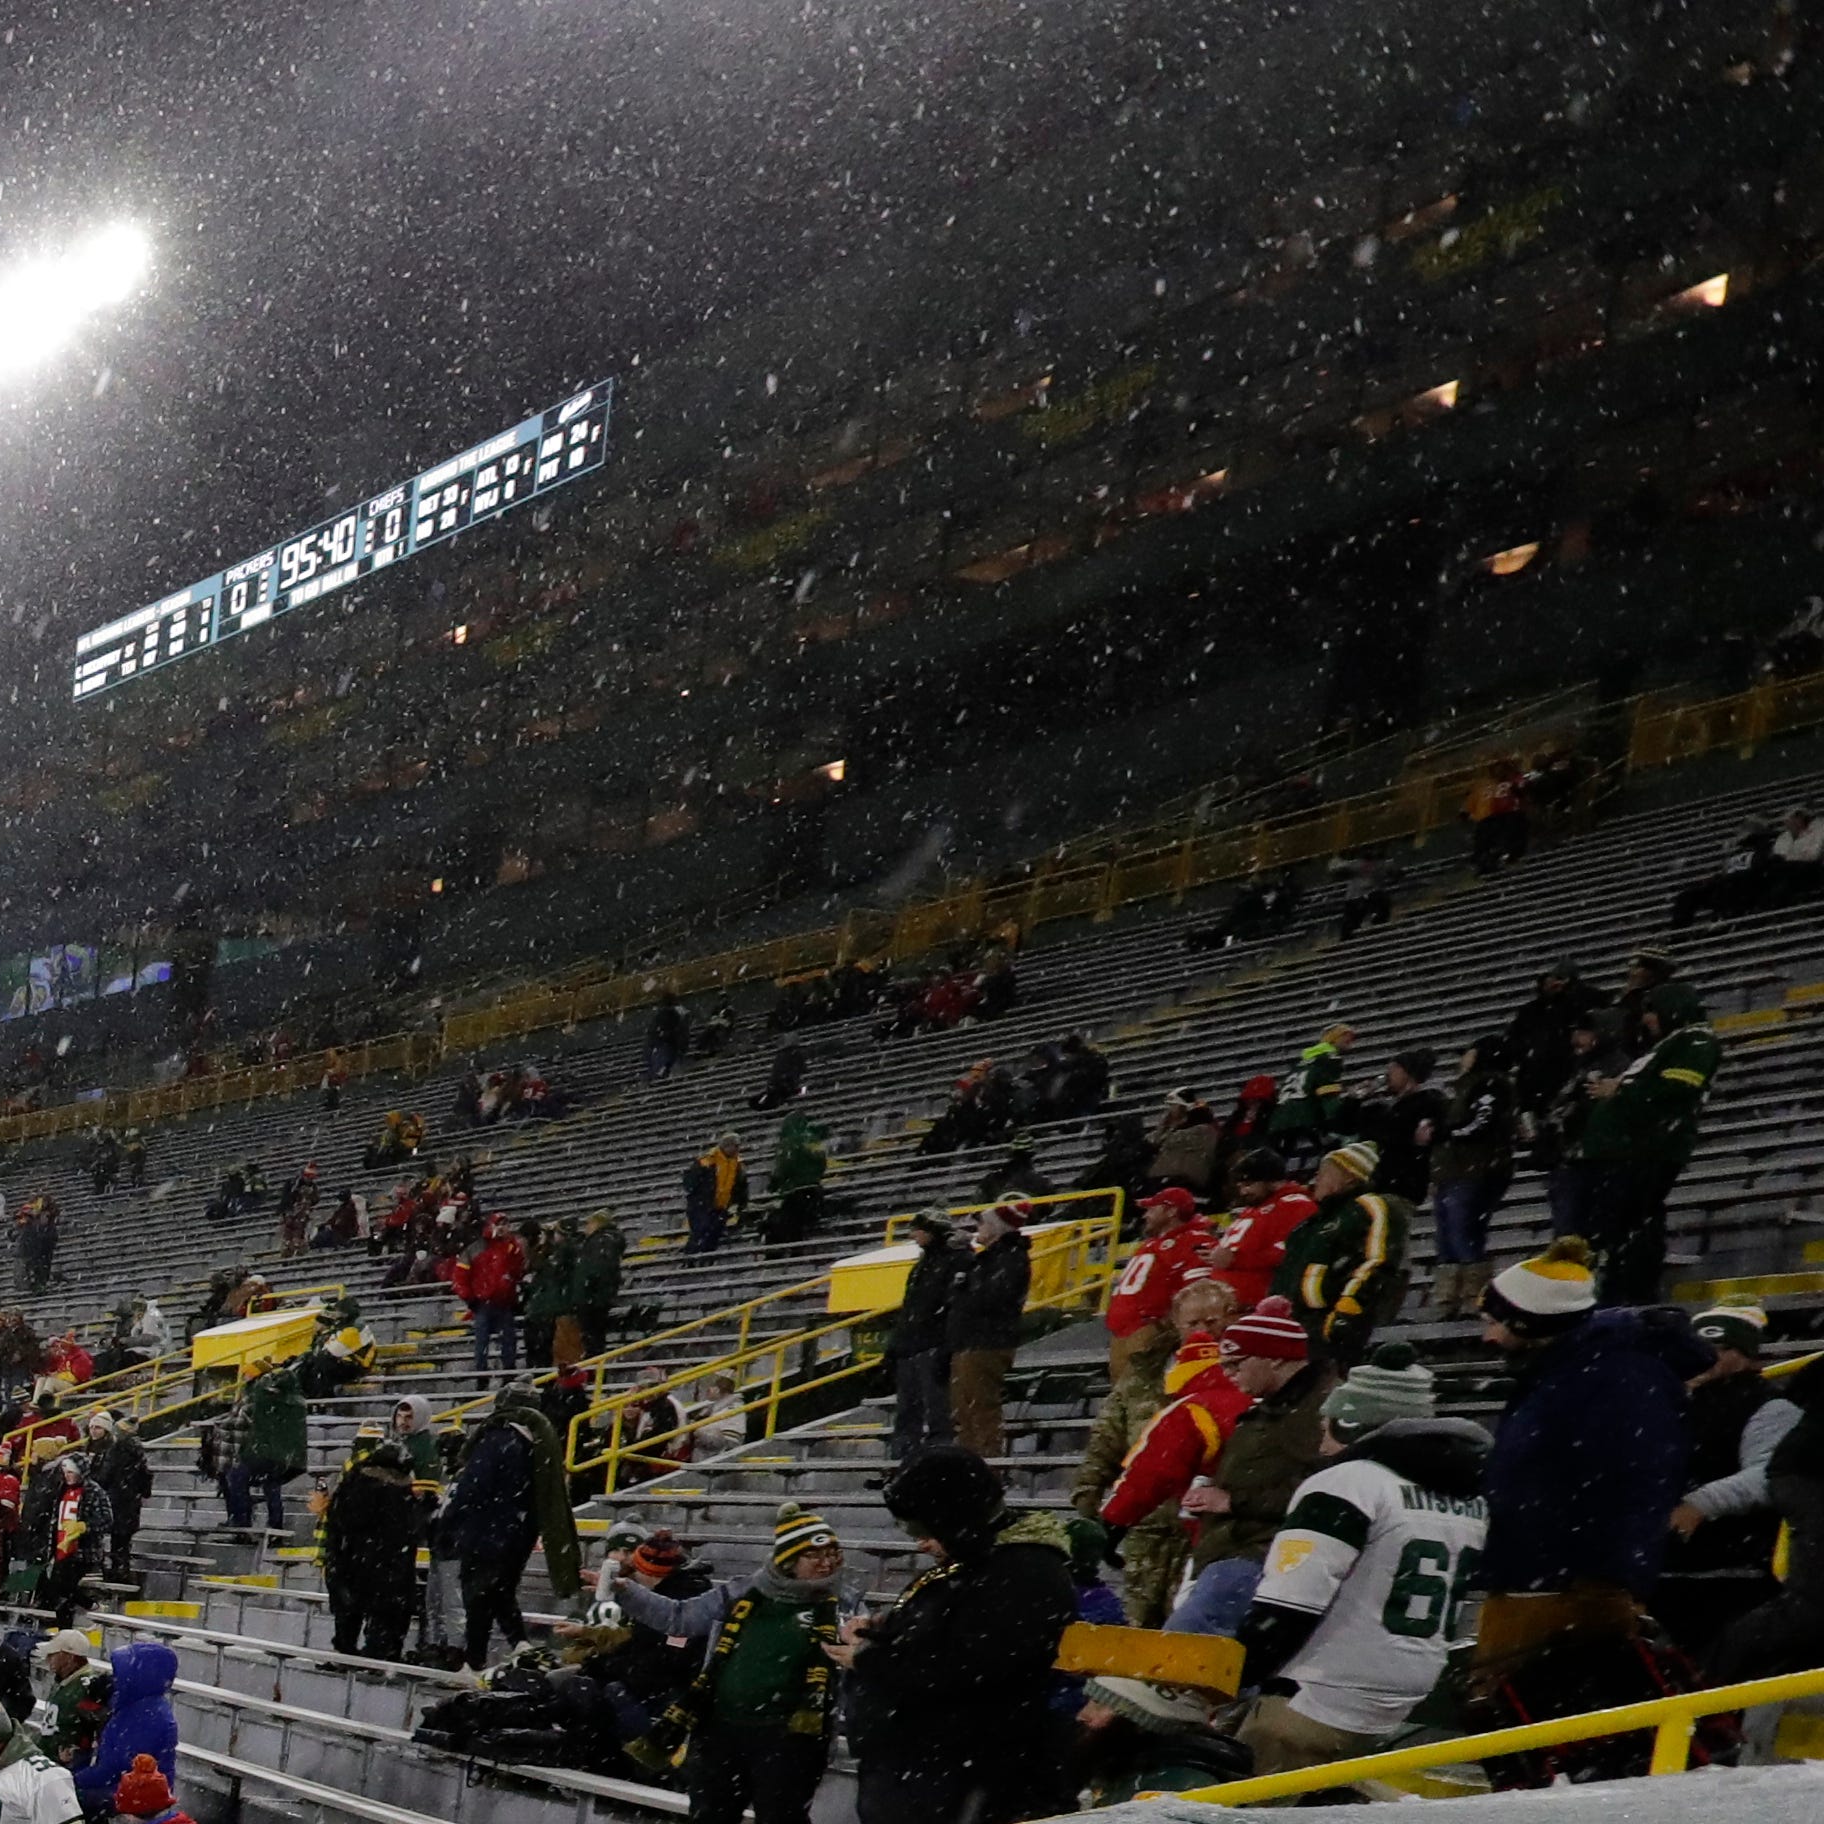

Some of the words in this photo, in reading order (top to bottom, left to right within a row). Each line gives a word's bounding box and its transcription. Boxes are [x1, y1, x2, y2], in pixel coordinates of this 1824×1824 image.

[570, 420, 588, 444] 24
[369, 487, 404, 517] CHIEFS
[385, 508, 401, 543] 0
[226, 551, 274, 585] PACKERS
[280, 515, 357, 589] 95:40
[230, 582, 247, 614] 0
